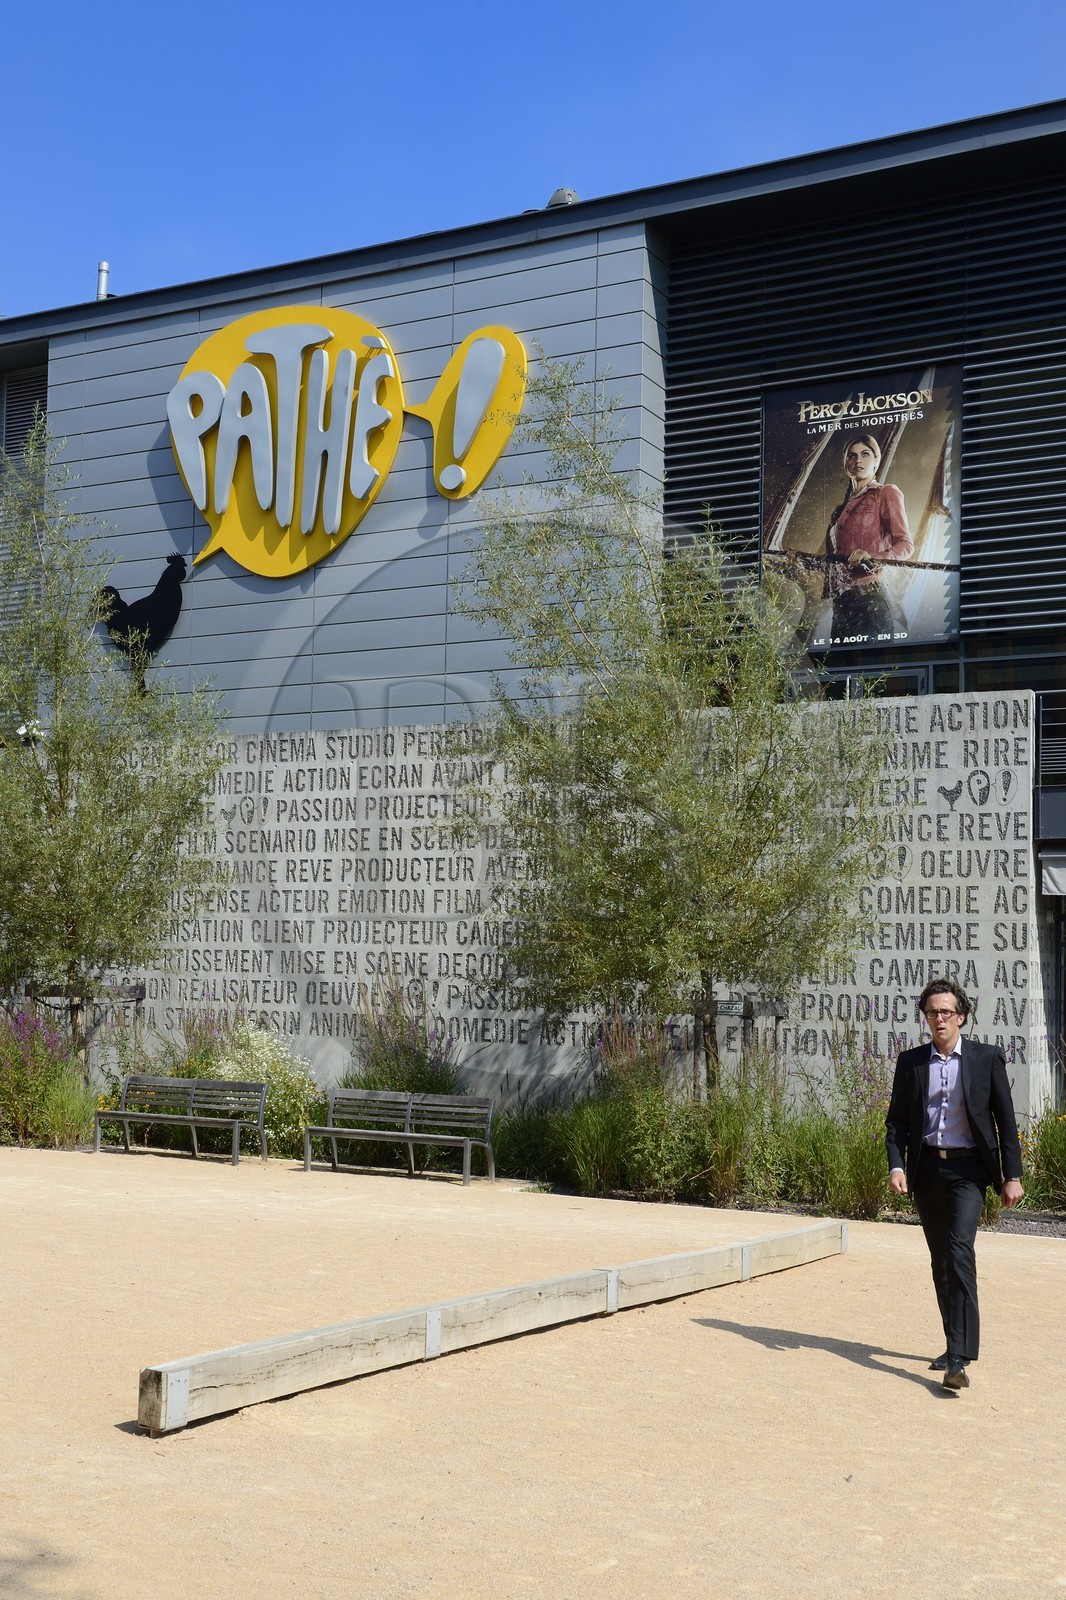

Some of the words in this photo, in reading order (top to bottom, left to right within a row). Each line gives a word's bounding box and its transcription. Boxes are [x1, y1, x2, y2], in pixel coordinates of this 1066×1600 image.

[797, 400, 852, 423] PERCY
[850, 389, 934, 416] JACKSON
[818, 422, 842, 433] MER
[844, 422, 860, 430] DES
[861, 411, 924, 427] MONSTRES
[813, 638, 826, 646] LE
[842, 634, 869, 644] AOÛT
[877, 633, 891, 641] EN
[893, 632, 908, 640] 3D
[246, 738, 317, 764] CINEMA
[325, 733, 395, 760] STUDIO
[929, 699, 1029, 733] ACTION
[197, 770, 274, 796] OMEDIE
[283, 766, 351, 793] ACTION
[359, 764, 423, 790] ECRAN
[432, 761, 495, 788] AVANT
[873, 740, 948, 771] NIME
[963, 737, 1028, 768] RIRE
[276, 797, 356, 823] PASSION
[365, 793, 491, 821] PROJECTEUR
[224, 829, 316, 855] SCENARIO
[324, 827, 370, 852] MISE
[378, 827, 403, 851] EN
[410, 826, 476, 850] SCENE
[959, 812, 1028, 842] REVE
[284, 859, 332, 883] REVE
[341, 857, 475, 883] PRODUCTEUR
[920, 848, 1028, 879] OEUVRE
[161, 889, 250, 913] USPENSE
[257, 889, 329, 913] ACTEUR
[337, 889, 425, 914] EMOTION
[433, 889, 481, 914] FILM
[859, 886, 980, 915] COMEDIE
[155, 919, 243, 943] ENSATION
[251, 919, 315, 944] CLIENT
[323, 919, 448, 945] PROJECTEUR
[456, 920, 535, 946] CAMER
[850, 922, 979, 951] REMIERE
[280, 949, 326, 975] MISE
[333, 950, 358, 975] EN
[364, 951, 429, 976] SCENE
[437, 952, 506, 978] DECOR
[869, 958, 979, 988] CAMERA
[178, 978, 297, 1004] REALISATEUR
[305, 980, 380, 1007] OEUVRE
[447, 984, 538, 1012] PASSIO
[238, 1009, 300, 1036] ESSIN
